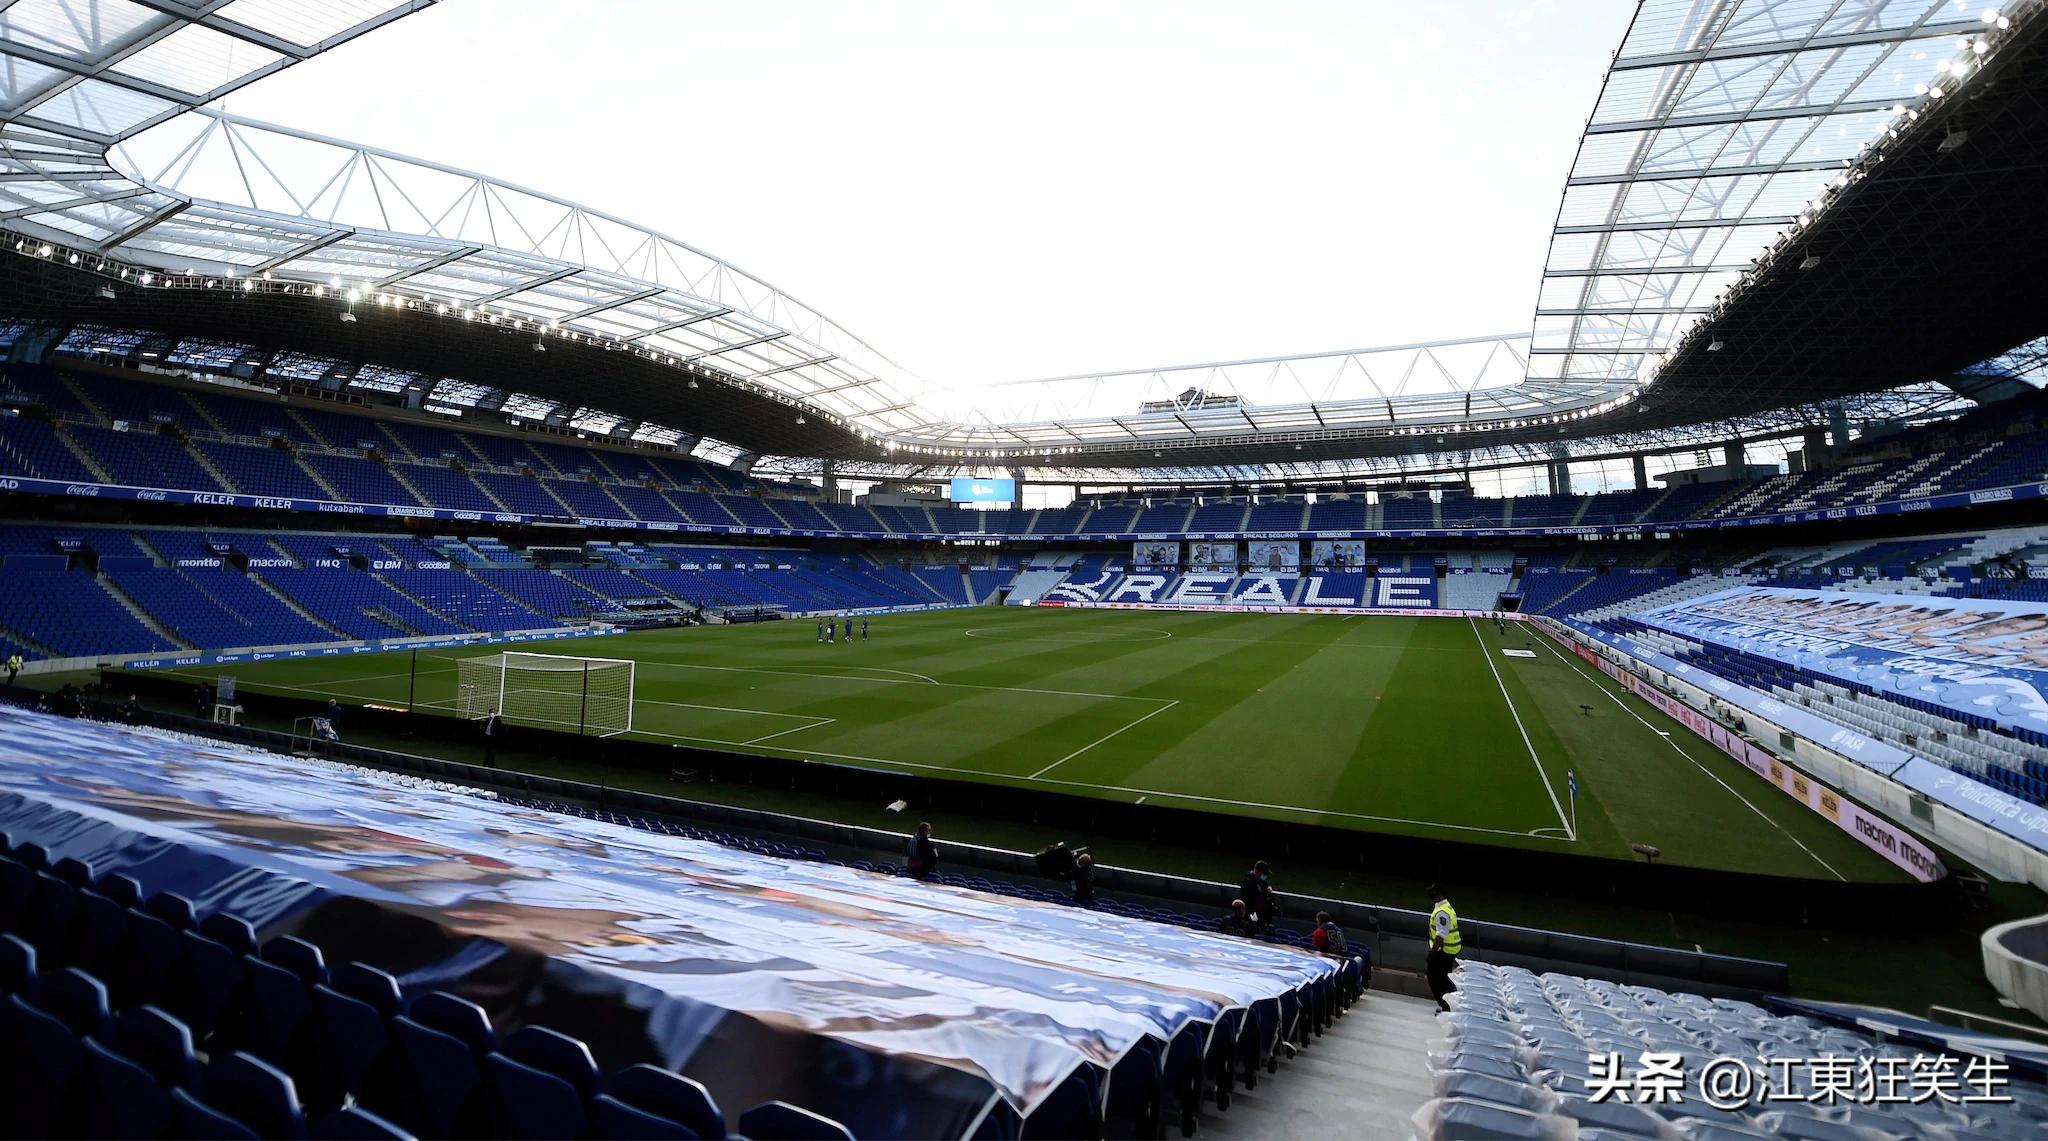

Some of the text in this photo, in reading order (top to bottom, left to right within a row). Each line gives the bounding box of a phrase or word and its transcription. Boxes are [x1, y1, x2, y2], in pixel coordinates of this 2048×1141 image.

[193, 493, 235, 506] KELER
[254, 498, 292, 510] KELER
[318, 503, 364, 514] kutxabank
[1855, 505, 1877, 516] KELER
[1826, 509, 1847, 519] KELER
[606, 521, 637, 529] SEGUROS
[249, 559, 293, 567] macron
[315, 559, 341, 568] IMQ
[384, 560, 402, 569] BM
[133, 660, 160, 668] KELER
[1854, 814, 1937, 880] macron macron
